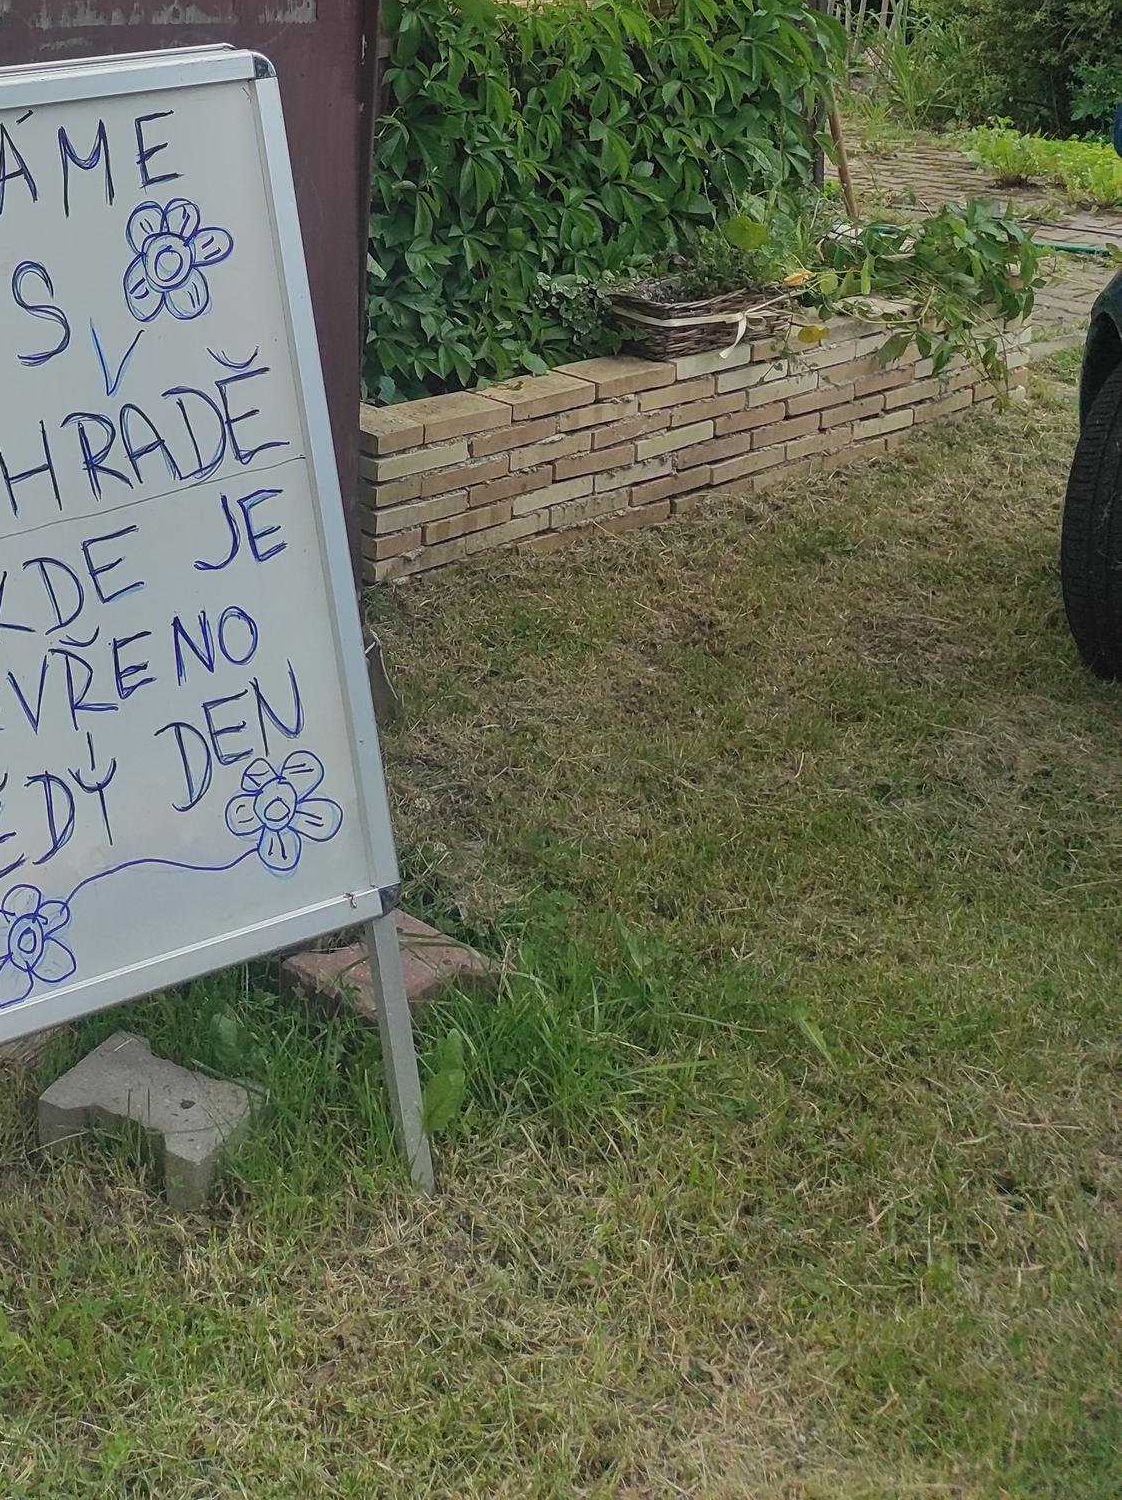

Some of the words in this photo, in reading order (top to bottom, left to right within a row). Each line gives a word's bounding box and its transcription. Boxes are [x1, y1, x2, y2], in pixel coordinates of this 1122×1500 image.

[89, 316, 145, 396] V
[193, 488, 288, 572] JE
[153, 658, 305, 813] DEN
